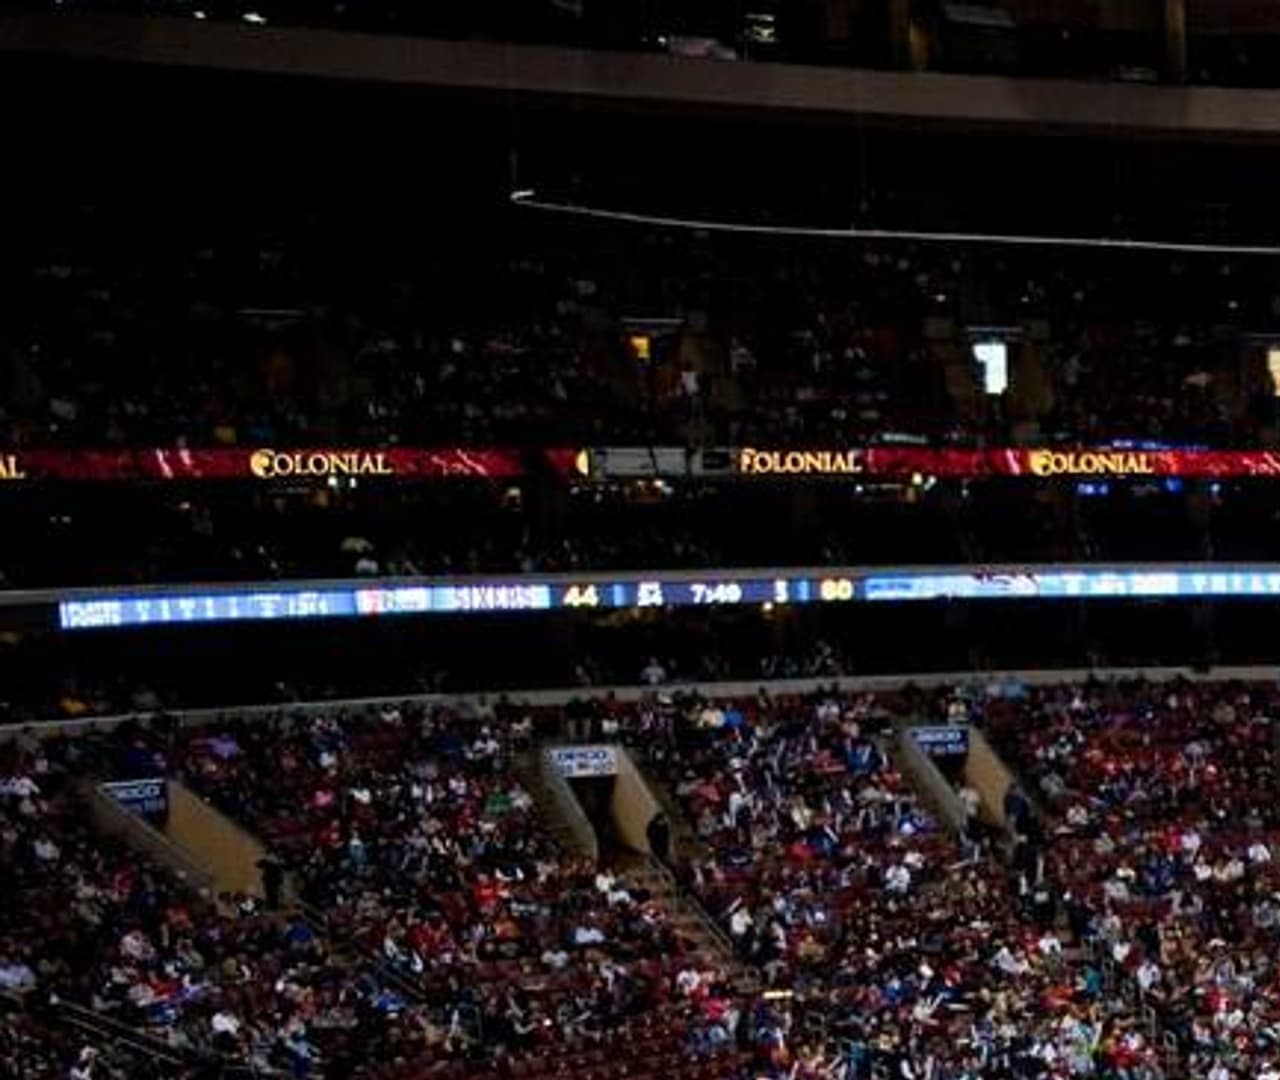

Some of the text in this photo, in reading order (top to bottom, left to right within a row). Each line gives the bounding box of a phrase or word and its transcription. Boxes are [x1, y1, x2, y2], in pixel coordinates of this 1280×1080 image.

[249, 450, 393, 478] COLONIAL
[1029, 448, 1153, 477] COLONIAL
[562, 585, 598, 606] 44
